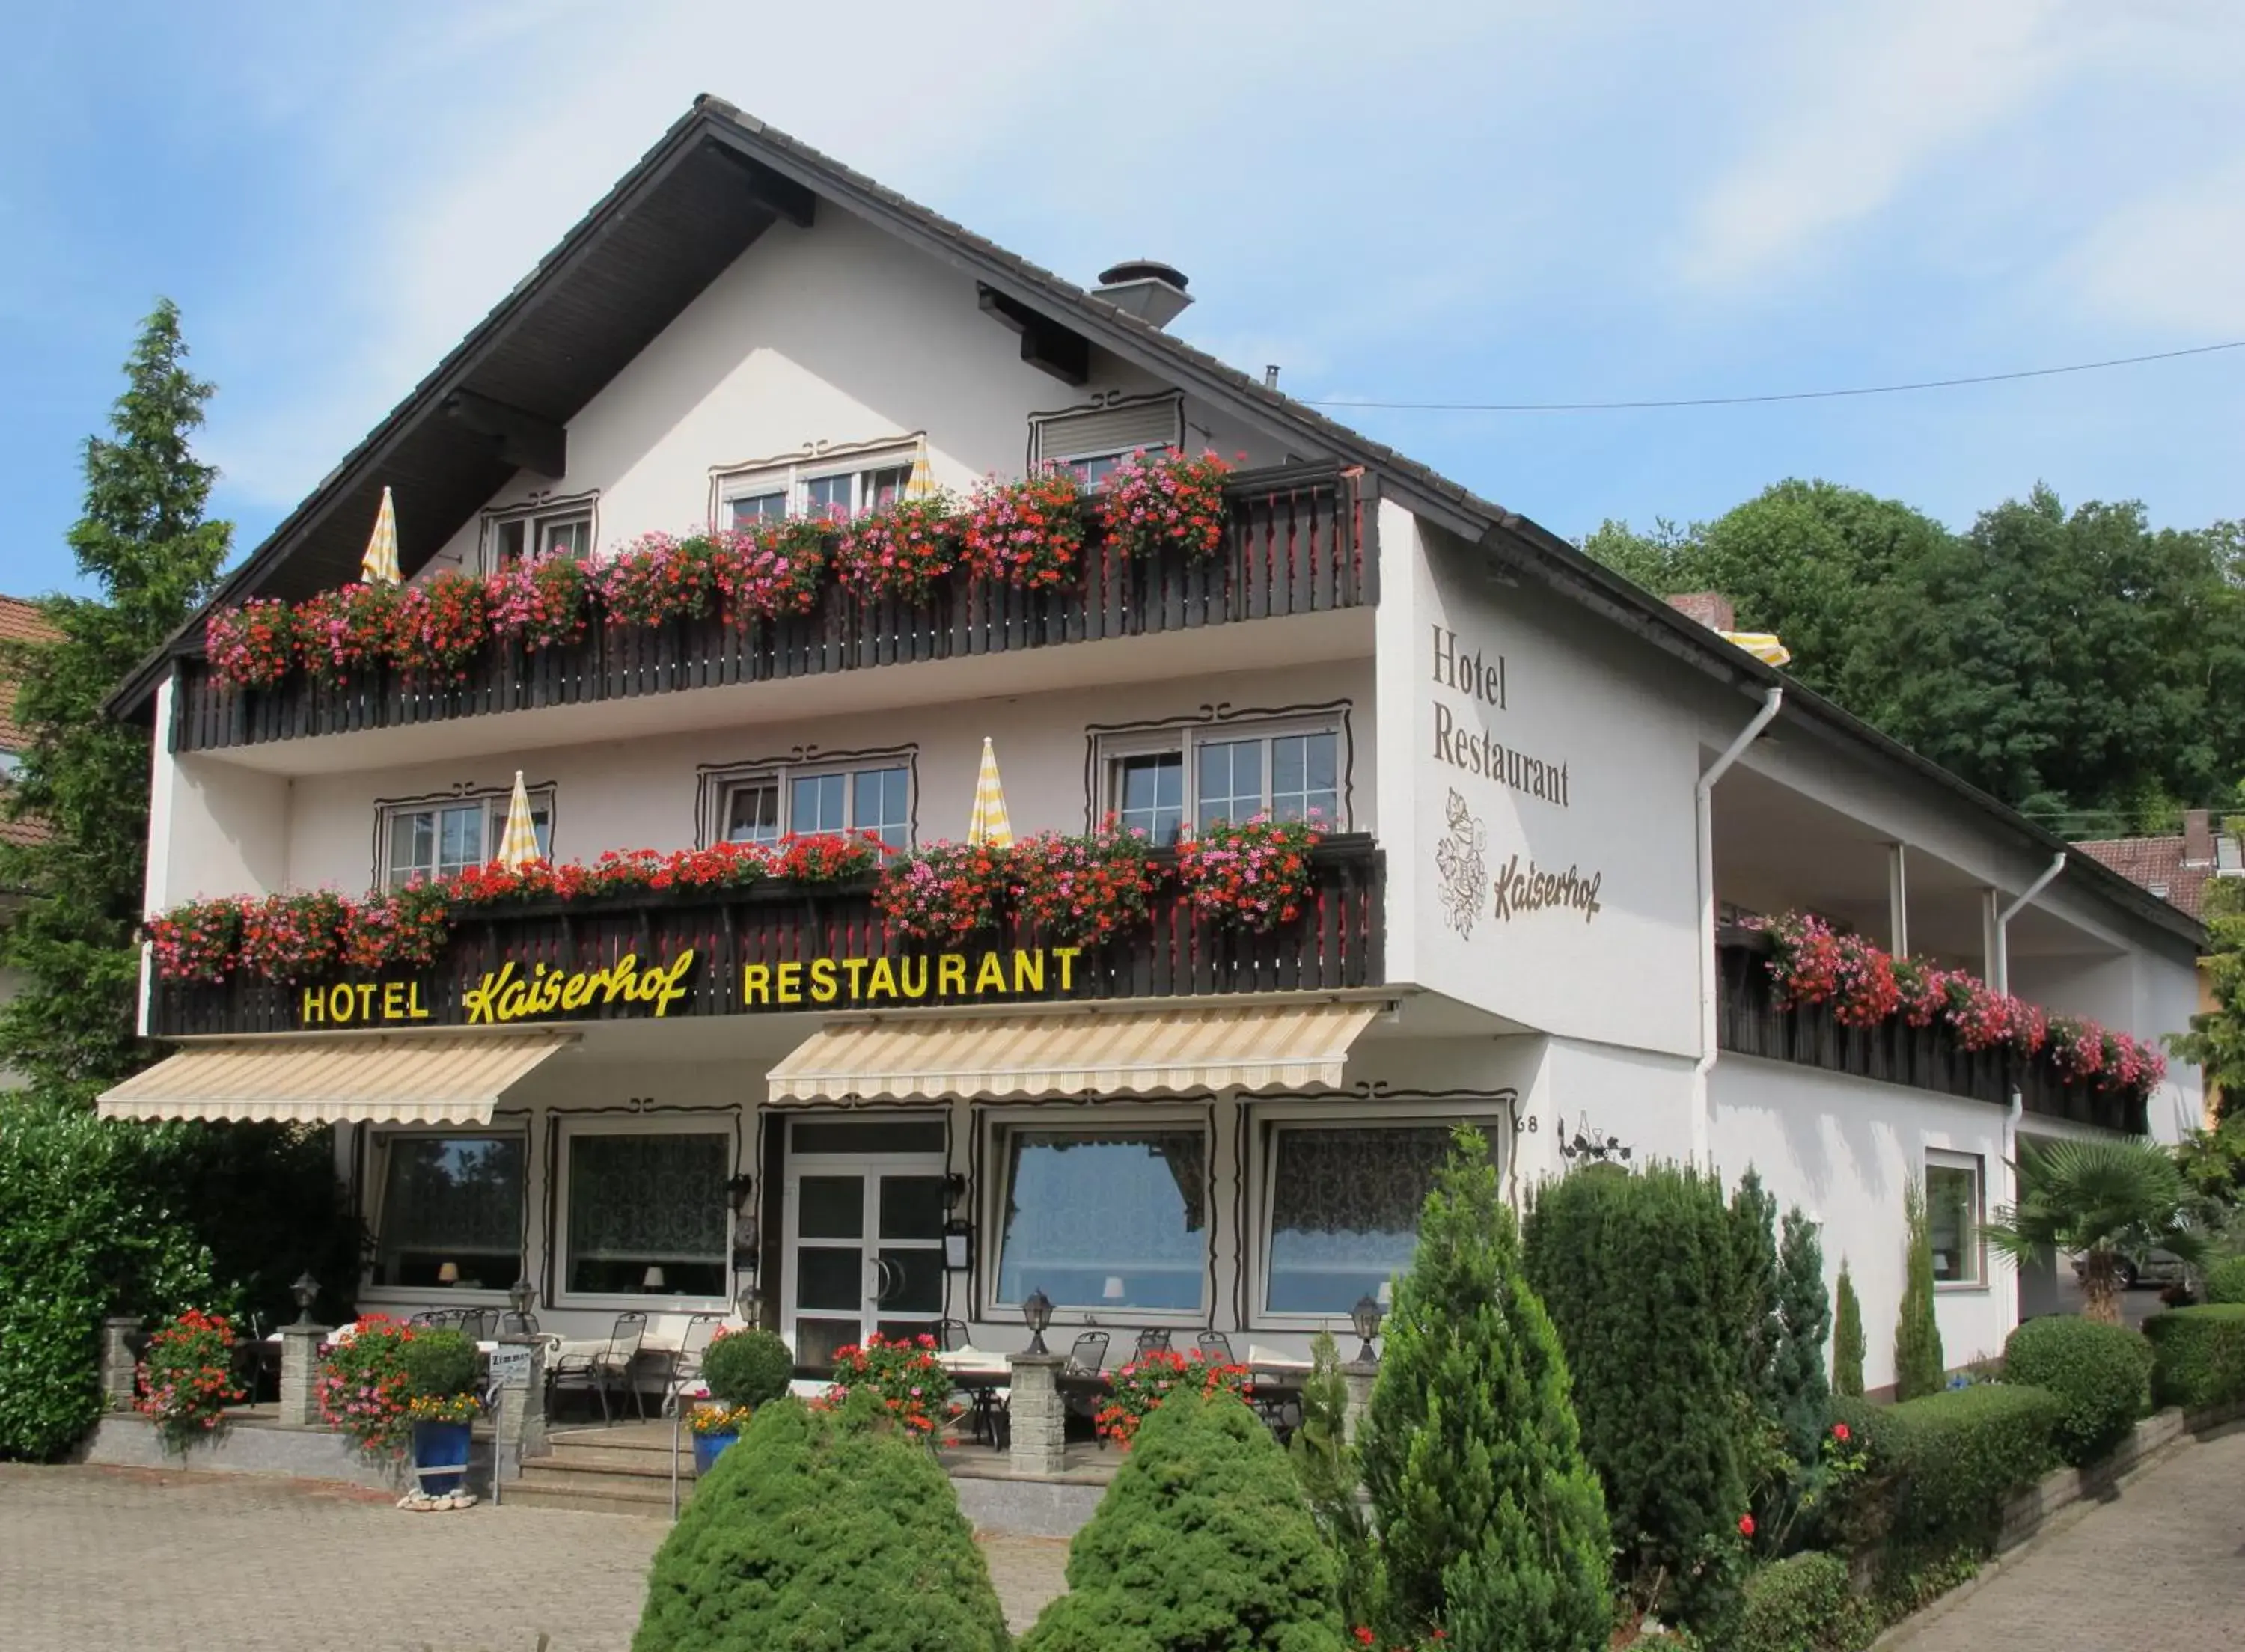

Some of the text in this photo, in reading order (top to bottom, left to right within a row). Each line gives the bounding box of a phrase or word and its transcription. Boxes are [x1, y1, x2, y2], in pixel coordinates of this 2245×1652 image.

[1431, 624, 1507, 711] Hotel
[1432, 700, 1569, 807] Restaurant
[1494, 854, 1601, 923] Kaiserhof
[304, 946, 1081, 1024] HOTEL Kaiserhof RESTAURANT
[1515, 1116, 1539, 1134] 68
